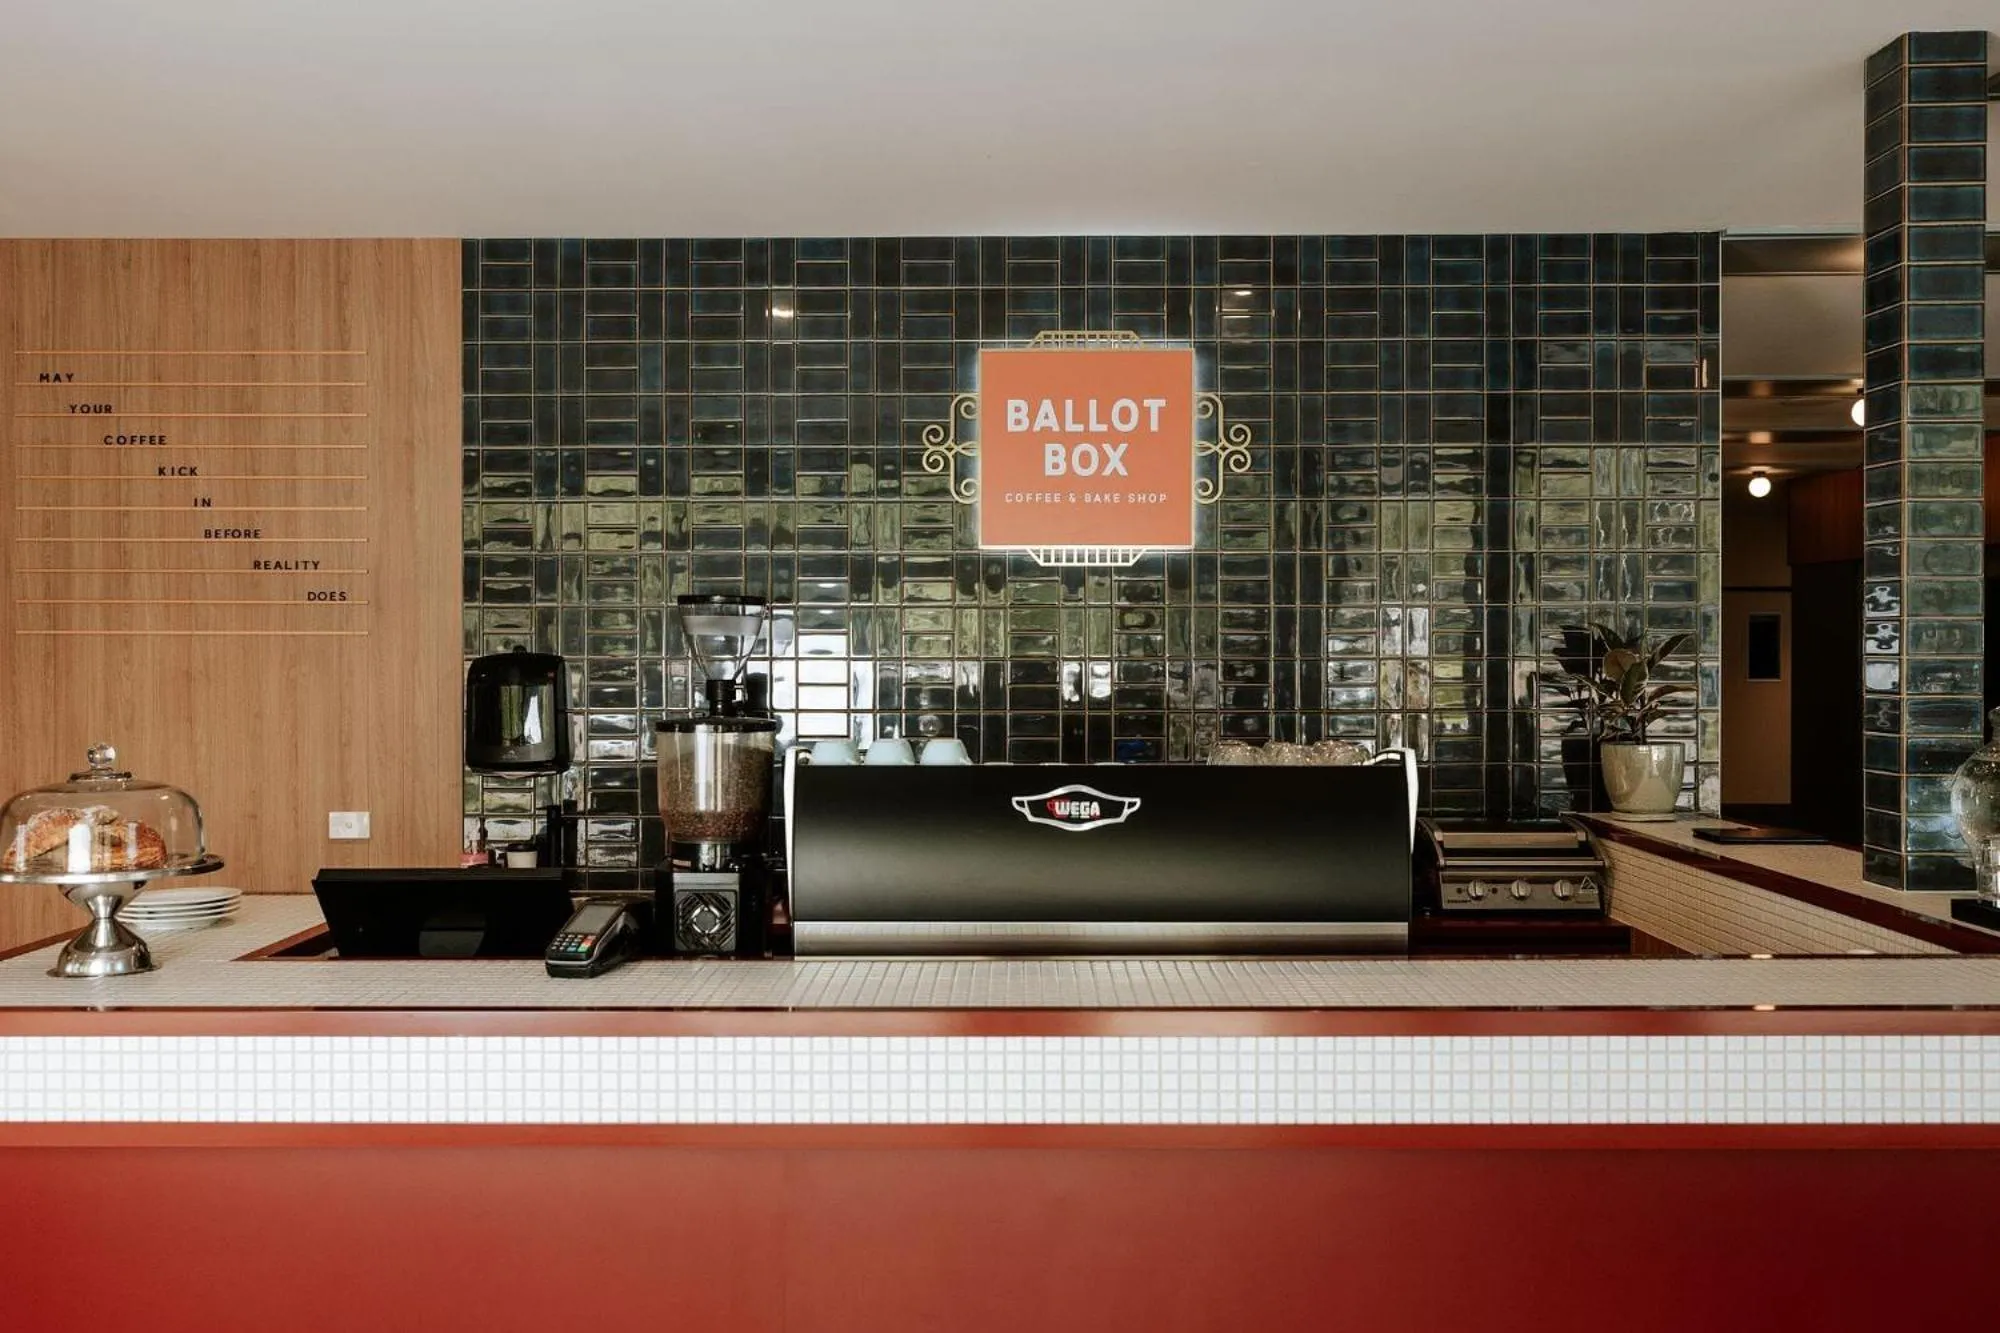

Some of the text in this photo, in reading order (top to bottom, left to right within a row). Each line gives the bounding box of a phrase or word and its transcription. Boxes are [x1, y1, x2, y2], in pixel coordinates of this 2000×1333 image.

[39, 373, 74, 383] MAY
[69, 404, 113, 414] YOUR
[1007, 398, 1166, 433] BALLOT
[103, 435, 167, 445] COFFEE
[1044, 443, 1129, 477] BOX
[158, 466, 198, 476] KICK
[193, 498, 212, 507] IN
[1005, 492, 1168, 504] COFFEE & BAKE SHOP
[203, 529, 261, 539] BEFORE
[253, 560, 320, 570] REALITY
[307, 591, 347, 601] DOES
[1054, 801, 1101, 819] WEGA
